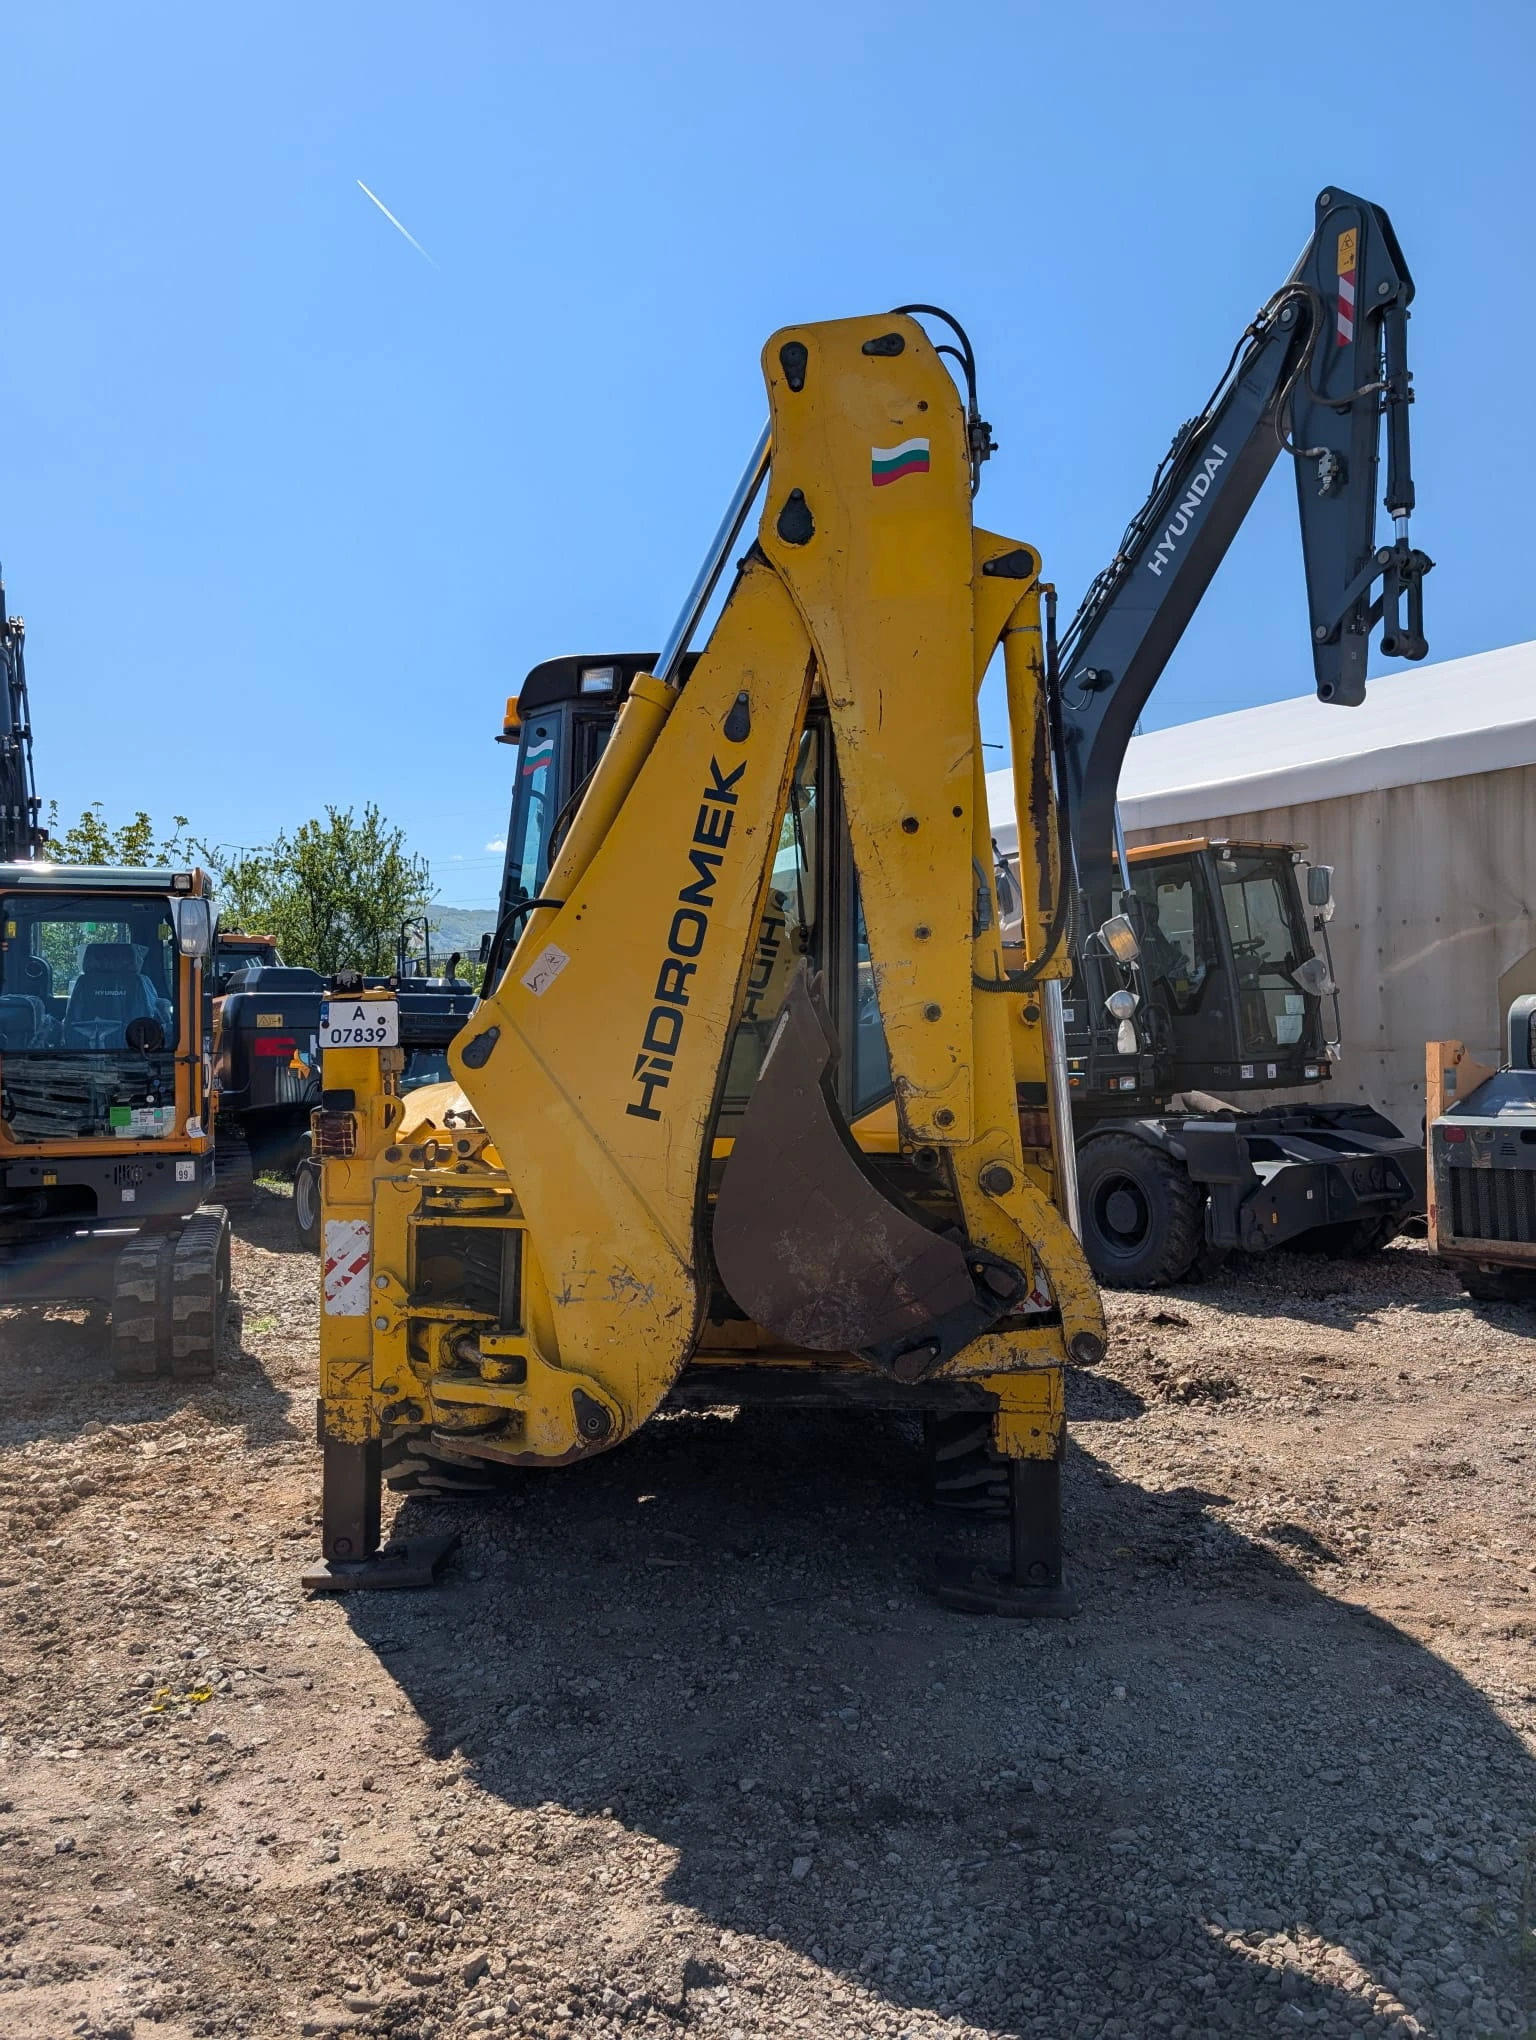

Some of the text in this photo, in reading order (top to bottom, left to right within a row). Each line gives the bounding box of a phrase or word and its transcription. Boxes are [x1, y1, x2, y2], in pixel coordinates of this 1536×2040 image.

[1147, 443, 1228, 577] HYUNDAI
[625, 753, 748, 1122] HIDROMEK
[352, 1005, 366, 1021] A
[330, 1027, 387, 1044] 07839
[178, 1169, 189, 1180] 99
